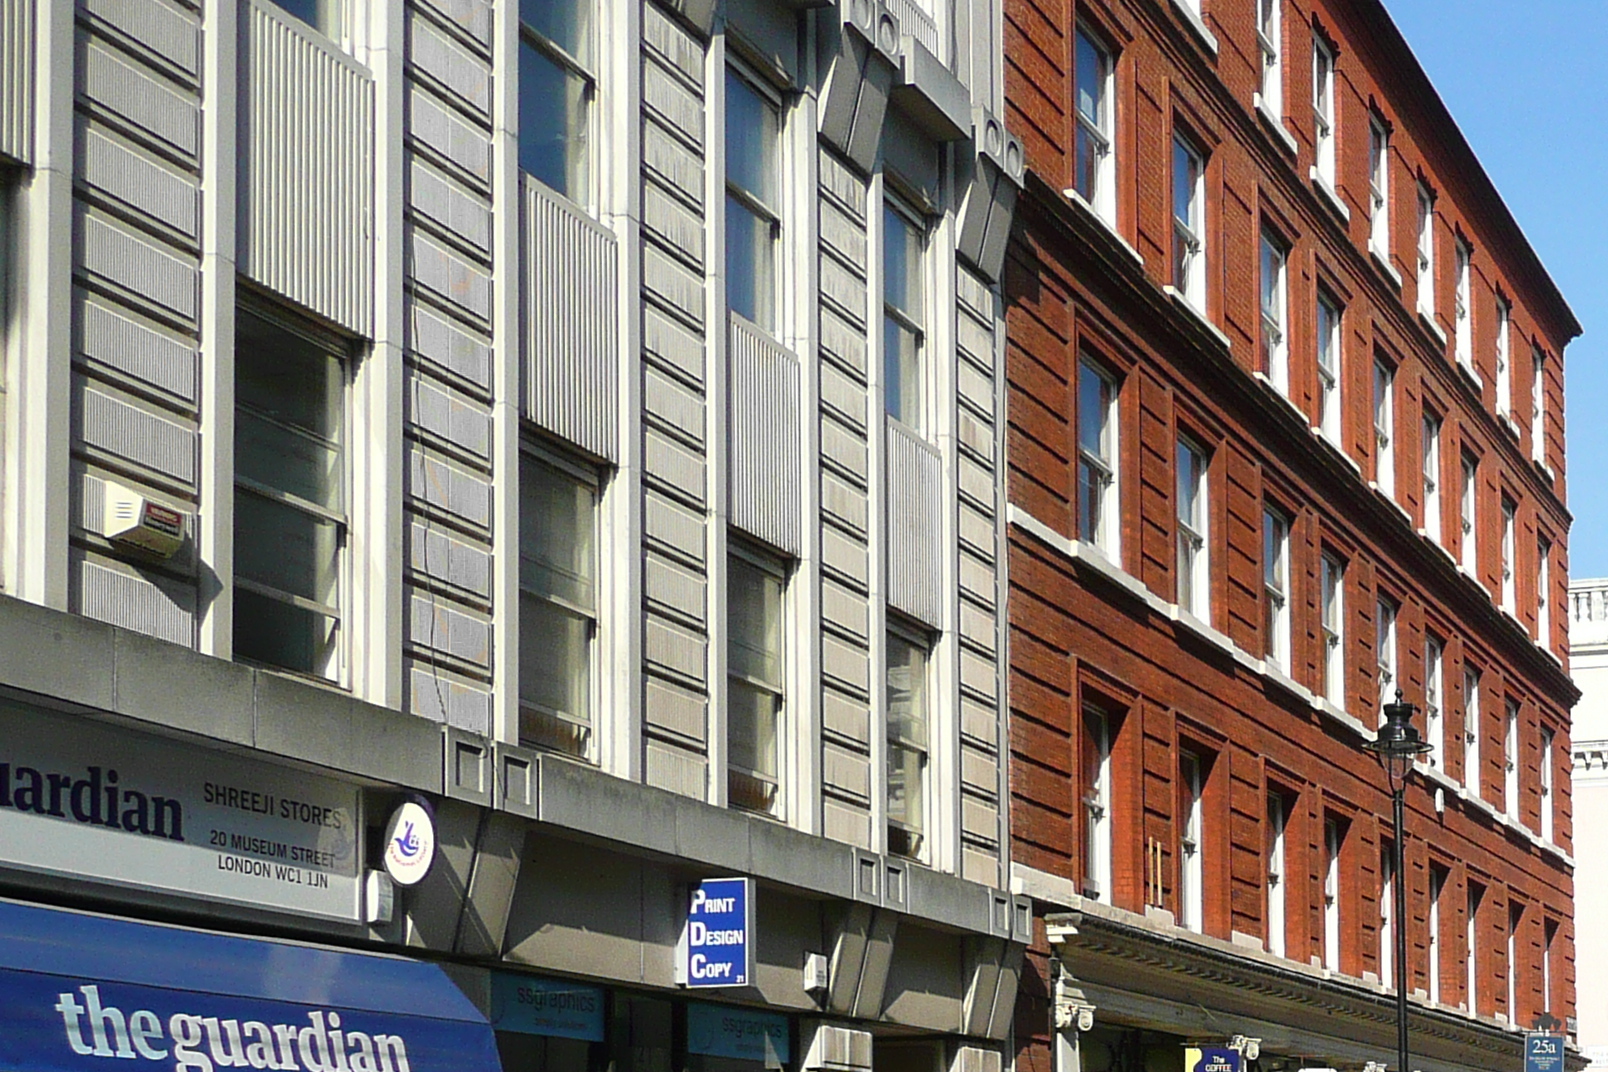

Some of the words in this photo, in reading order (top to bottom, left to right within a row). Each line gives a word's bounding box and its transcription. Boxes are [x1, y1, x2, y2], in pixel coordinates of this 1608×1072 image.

[203, 782, 275, 816] SHREEJI
[280, 799, 342, 830] STORES
[209, 830, 228, 847] 20
[230, 833, 288, 859] MUSEUM
[290, 845, 336, 868] STREET
[218, 855, 271, 879] LONDON
[275, 867, 302, 885] WC1
[306, 871, 329, 889] 1JN
[516, 985, 595, 1015] ssgraphics
[55, 984, 169, 1061] the
[721, 1015, 783, 1040] ssgraphics
[1212, 1055, 1225, 1063] The
[1532, 1039, 1557, 1054] 25a
[1204, 1064, 1233, 1072] COFFEE
